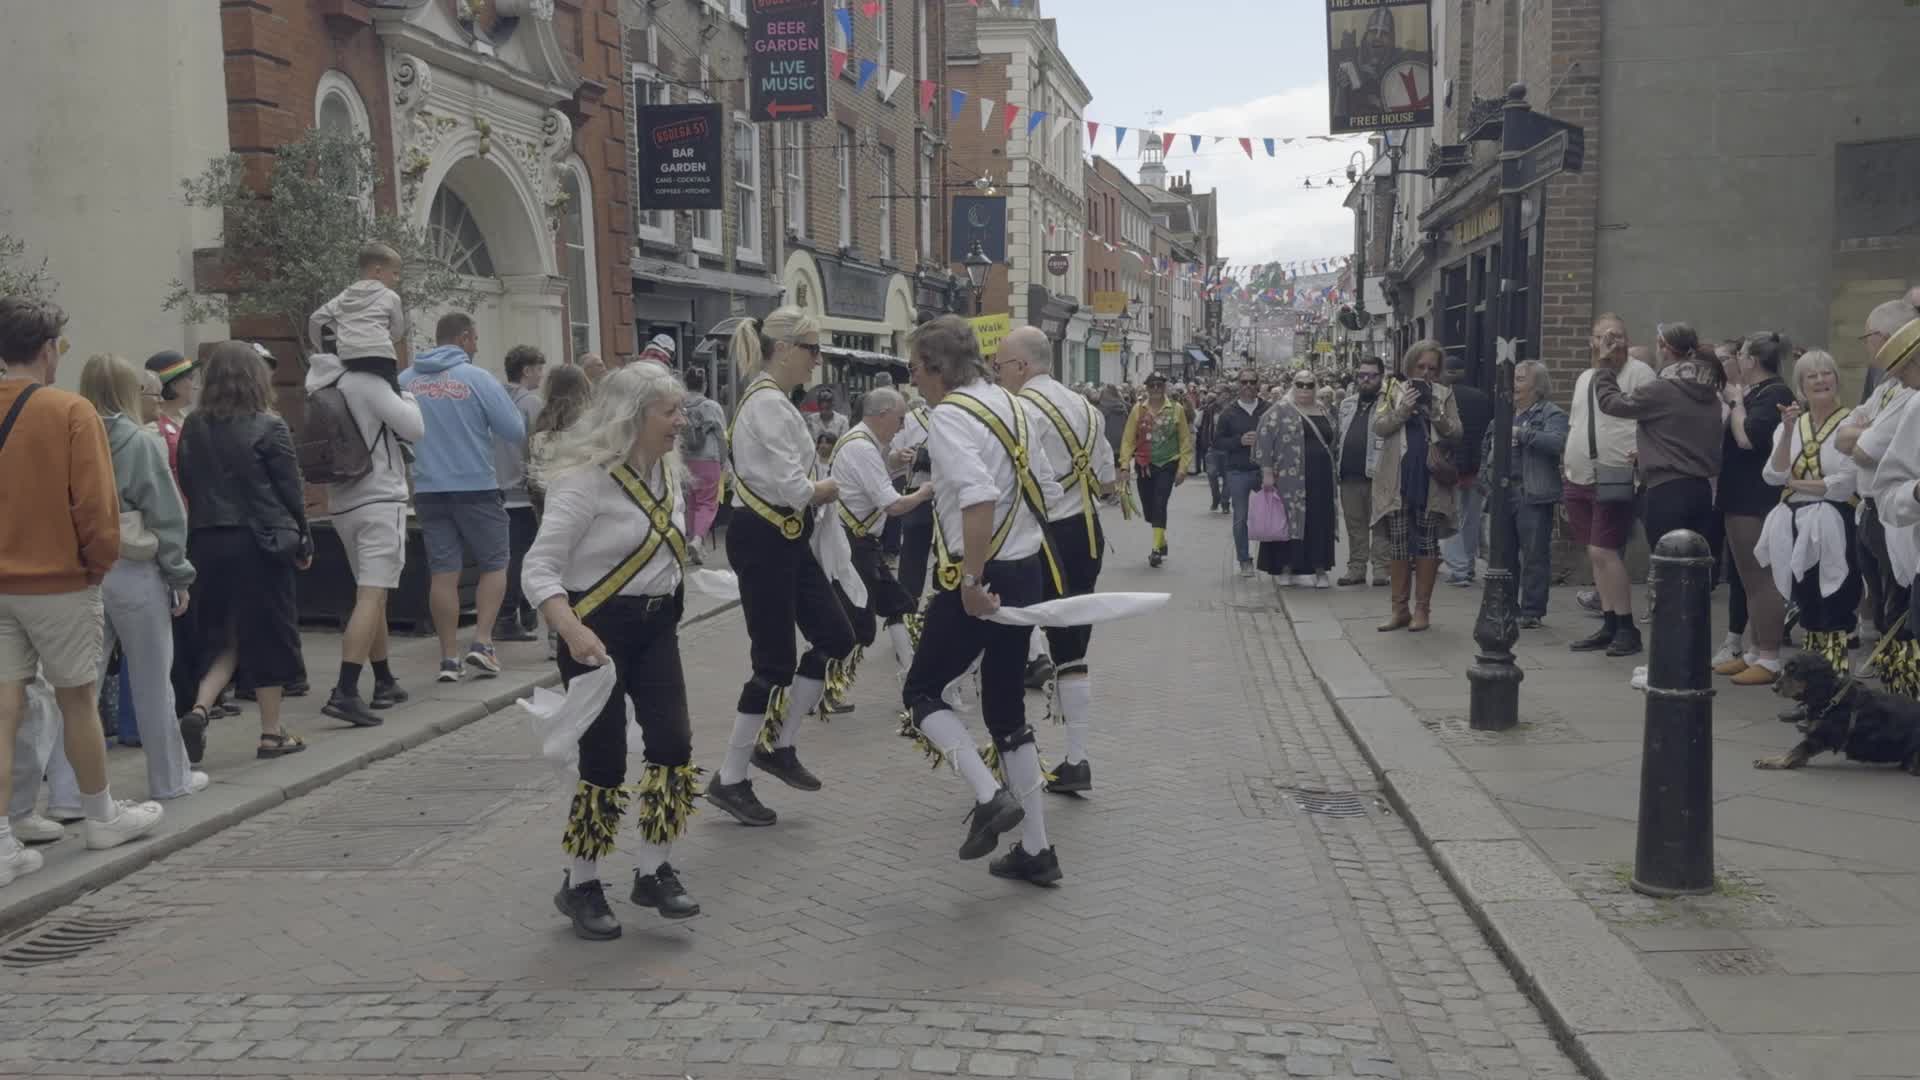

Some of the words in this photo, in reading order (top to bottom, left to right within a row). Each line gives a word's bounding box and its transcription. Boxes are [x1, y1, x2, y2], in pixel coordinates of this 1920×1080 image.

[767, 22, 806, 35] BEER
[754, 38, 819, 52] GARDEN
[770, 61, 806, 74] LIVE
[761, 76, 815, 91] MUSIC
[1350, 115, 1378, 127] FREE
[1381, 111, 1415, 124] HOUSE
[672, 148, 694, 158] BAR
[660, 162, 706, 173] GARDEN
[978, 322, 1002, 332] Walk
